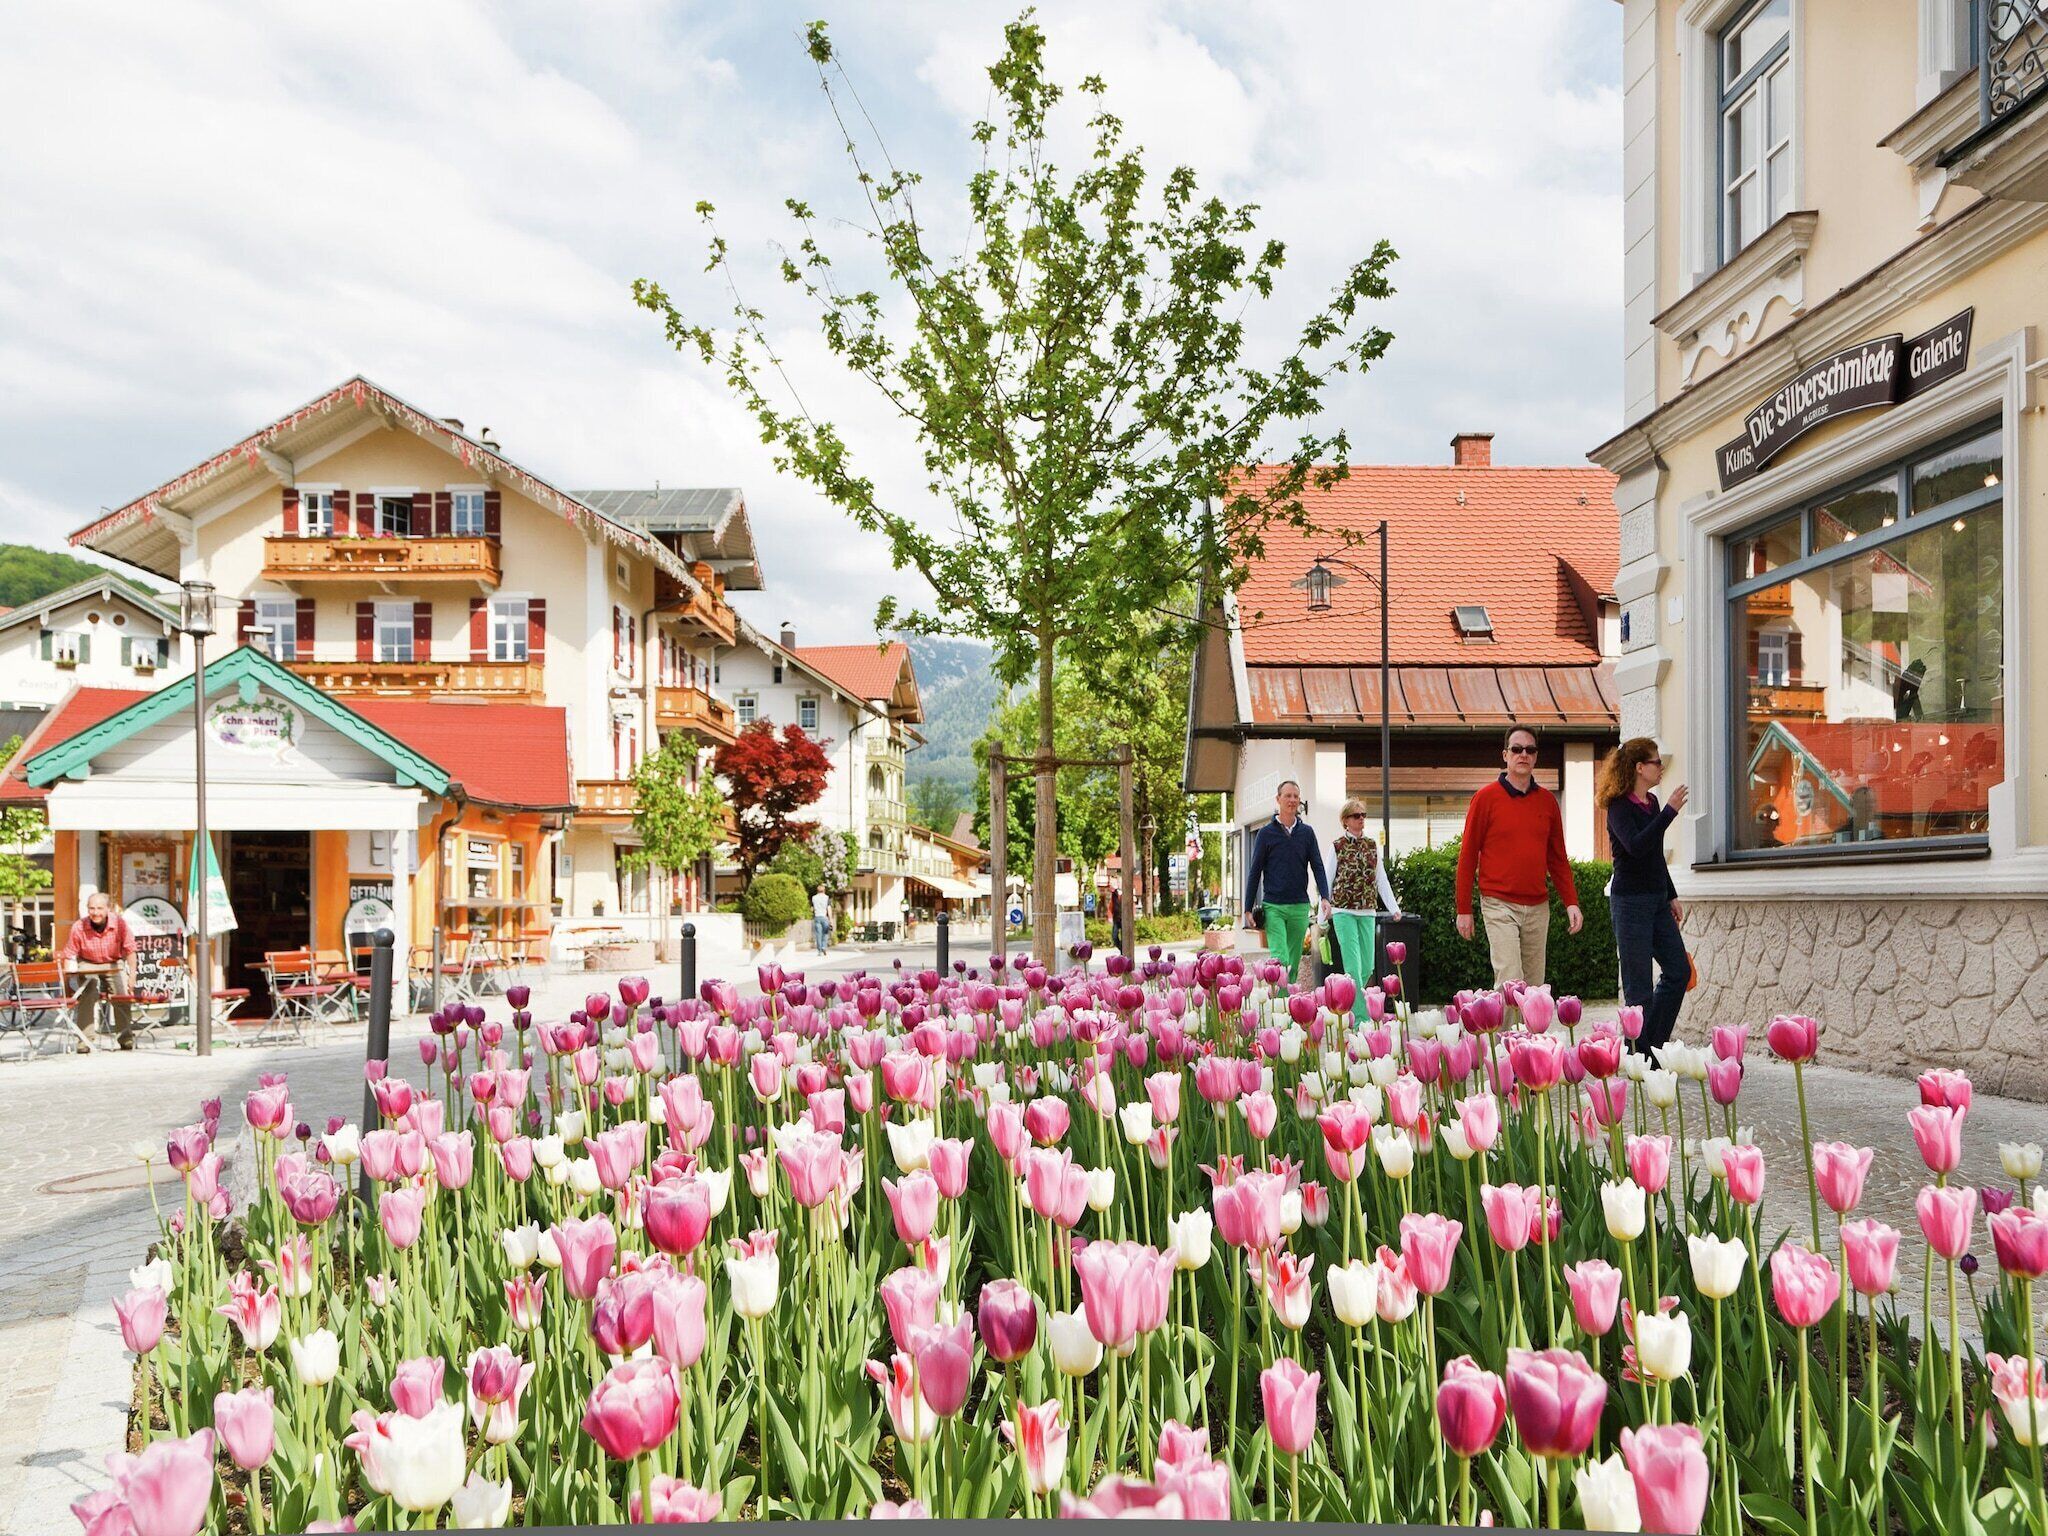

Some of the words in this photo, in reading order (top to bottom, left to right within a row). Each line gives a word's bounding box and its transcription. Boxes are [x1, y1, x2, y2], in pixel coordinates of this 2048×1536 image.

[1910, 327, 1963, 379] Galerie
[1749, 407, 1775, 449] Die
[1775, 343, 1895, 427] Silberschmiede
[350, 883, 392, 901] GETRÄN
